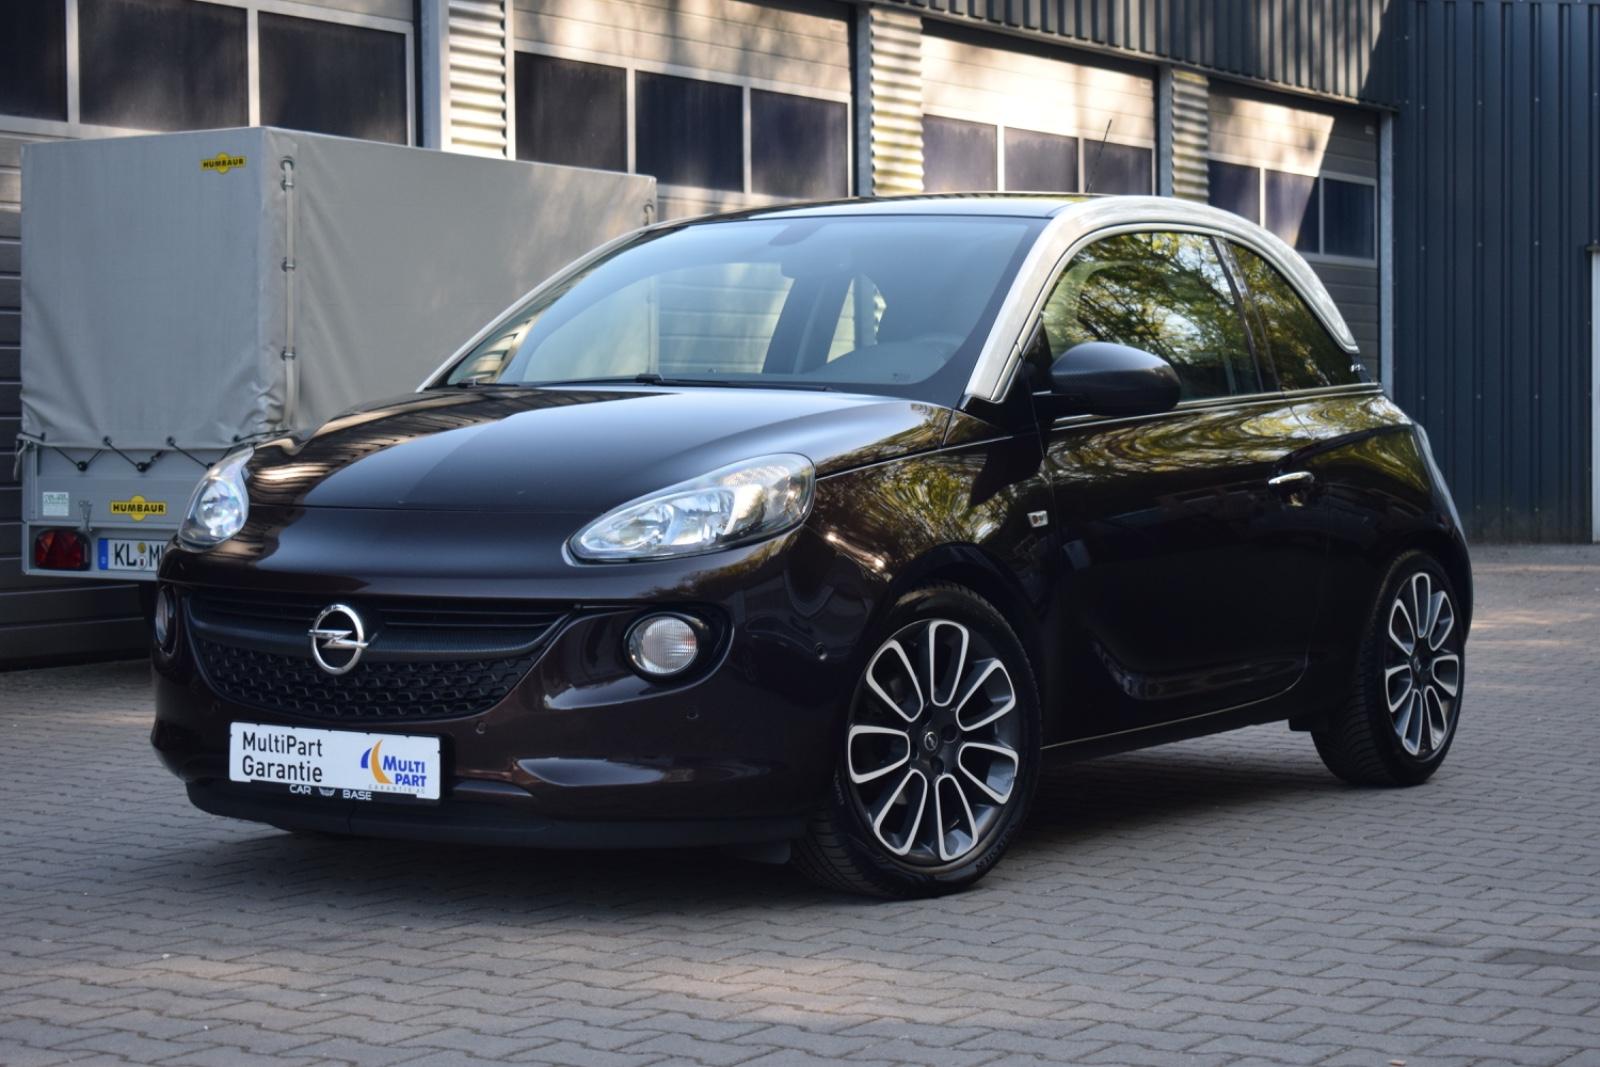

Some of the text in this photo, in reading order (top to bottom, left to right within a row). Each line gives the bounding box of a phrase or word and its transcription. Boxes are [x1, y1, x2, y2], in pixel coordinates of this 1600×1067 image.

[203, 158, 244, 168] HUMBAUR
[112, 503, 165, 513] HUMBAUR
[113, 543, 166, 567] KL M
[242, 731, 323, 757] MultiPart
[242, 754, 323, 783] Garantie
[395, 773, 427, 787] PART
[289, 784, 372, 801] CAR BASE
